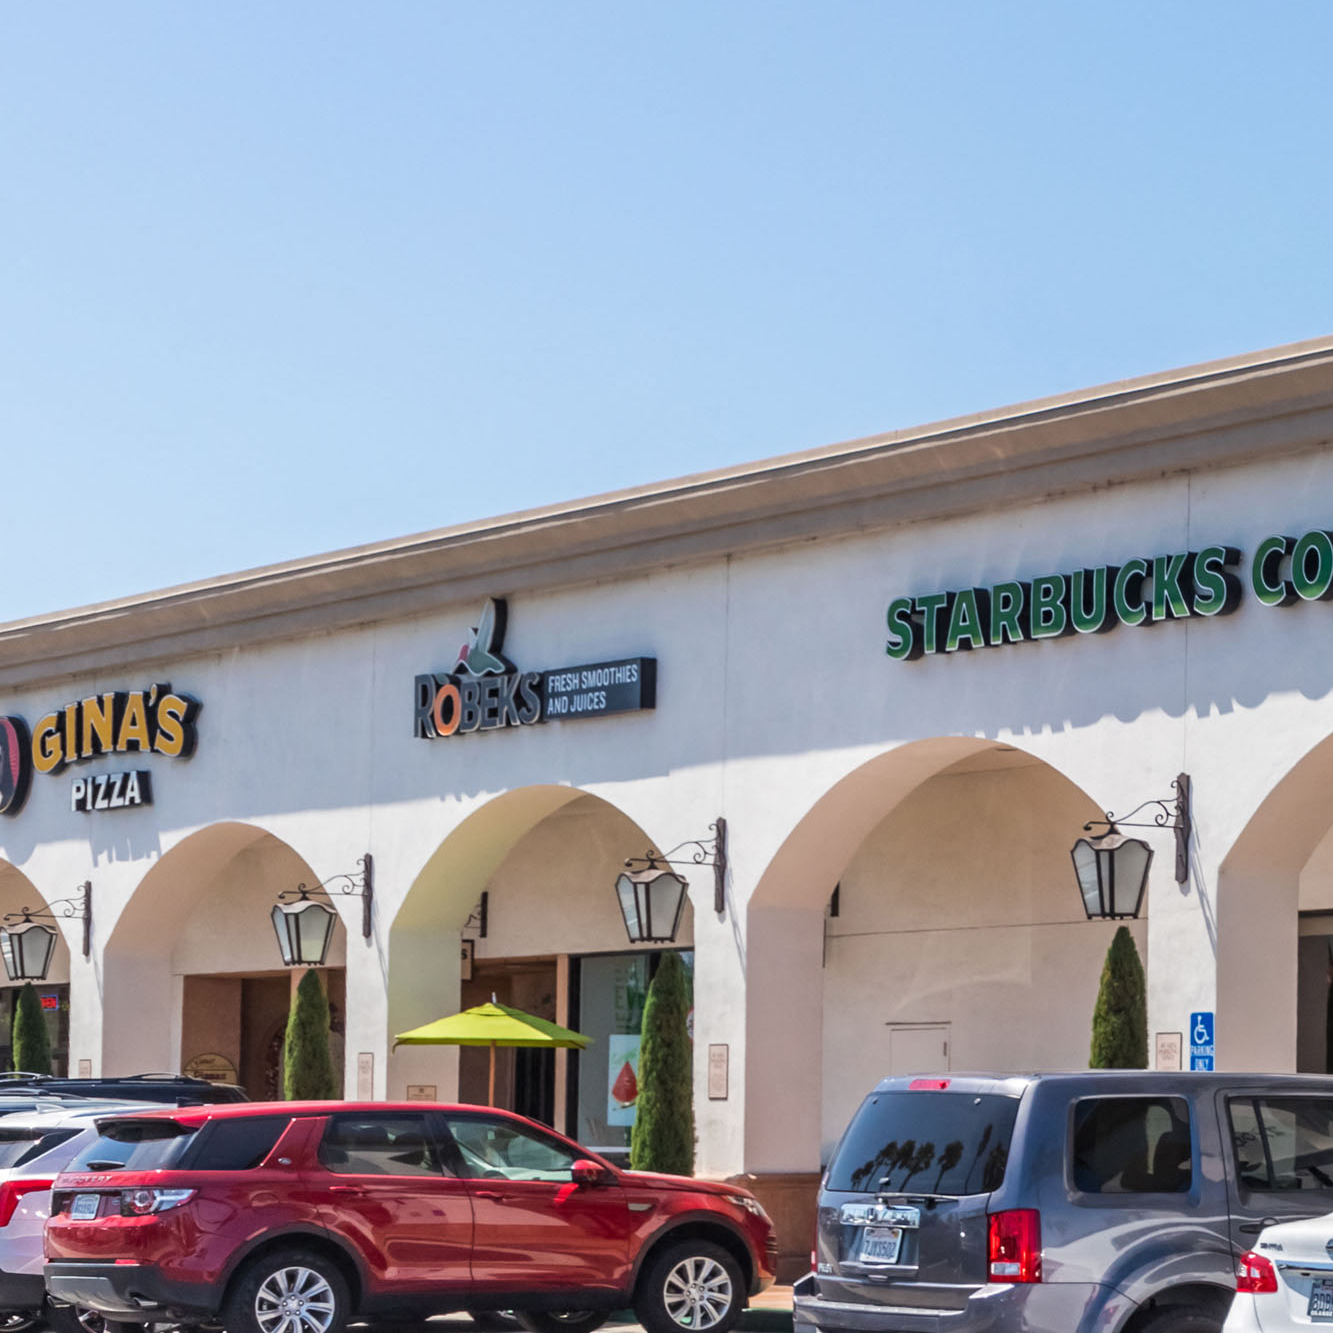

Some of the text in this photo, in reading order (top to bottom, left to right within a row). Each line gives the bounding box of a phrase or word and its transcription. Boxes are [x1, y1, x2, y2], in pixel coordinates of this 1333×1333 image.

[885, 545, 1242, 662] STARBUCKS
[414, 671, 541, 739] ROBEKS
[547, 691, 607, 715] AND JUICES
[548, 664, 639, 694] FRESH SMOOTHIES
[31, 682, 190, 774] GINA'S
[71, 770, 143, 812] PIZZA
